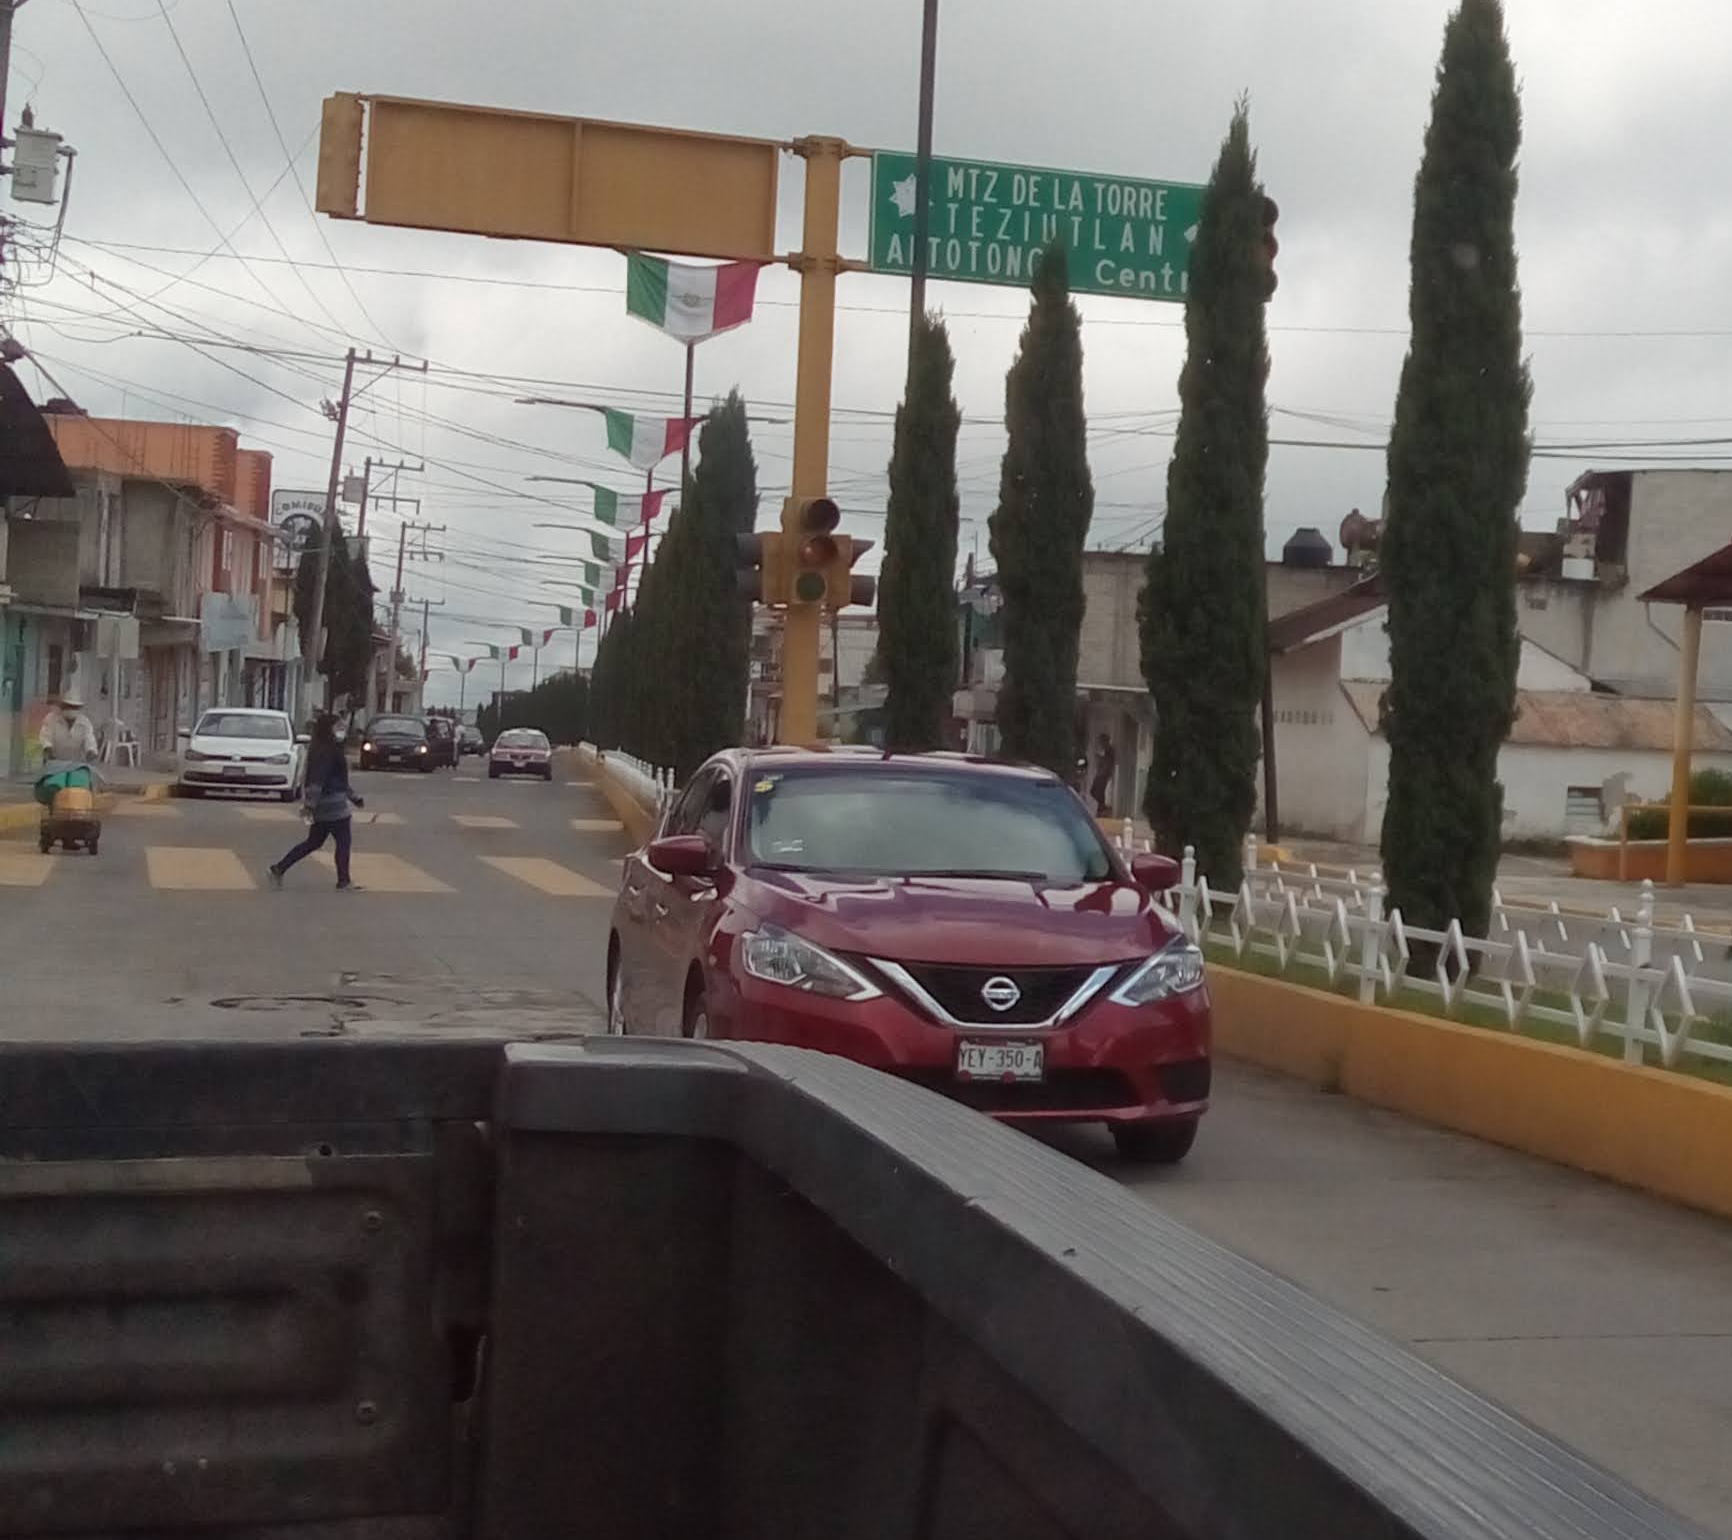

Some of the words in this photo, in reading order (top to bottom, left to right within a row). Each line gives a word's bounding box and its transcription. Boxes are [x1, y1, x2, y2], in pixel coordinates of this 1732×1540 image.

[947, 166, 999, 204] MTZ
[1012, 173, 1043, 207] DE
[1053, 178, 1084, 212] LA
[1094, 182, 1168, 221] TORRE
[946, 203, 1164, 257] TEZIUTLAN
[1095, 259, 1190, 294] Centr
